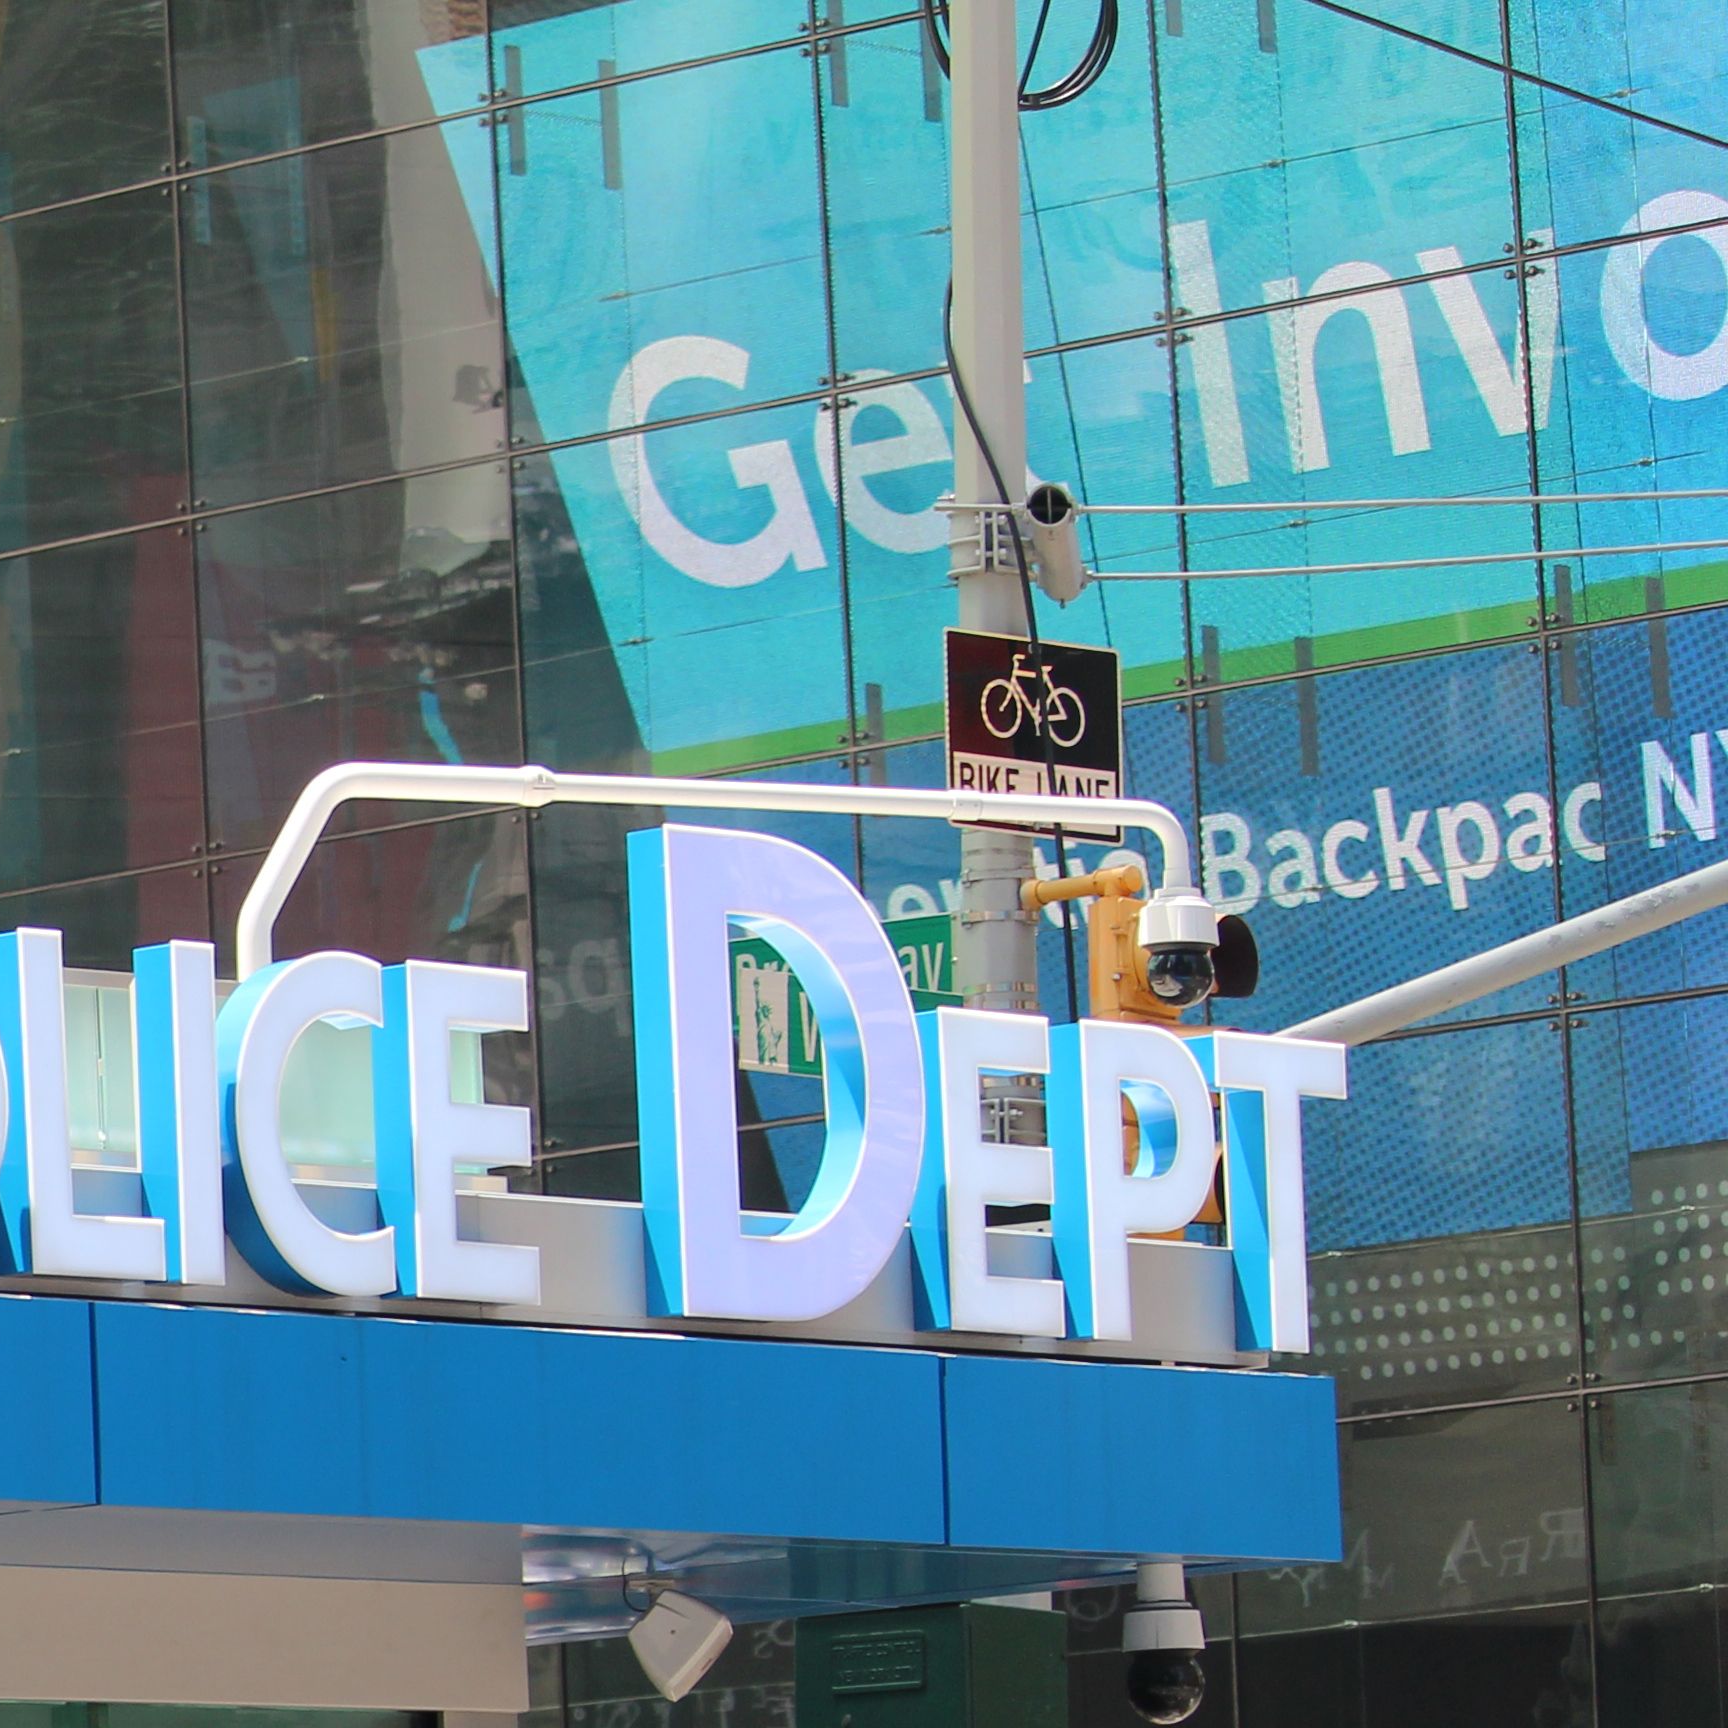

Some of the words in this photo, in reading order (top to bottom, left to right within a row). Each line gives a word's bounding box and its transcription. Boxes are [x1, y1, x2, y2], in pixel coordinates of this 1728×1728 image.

[607, 333, 1036, 590] Ge
[1640, 728, 1728, 850] N
[627, 823, 1347, 1355] DEPT
